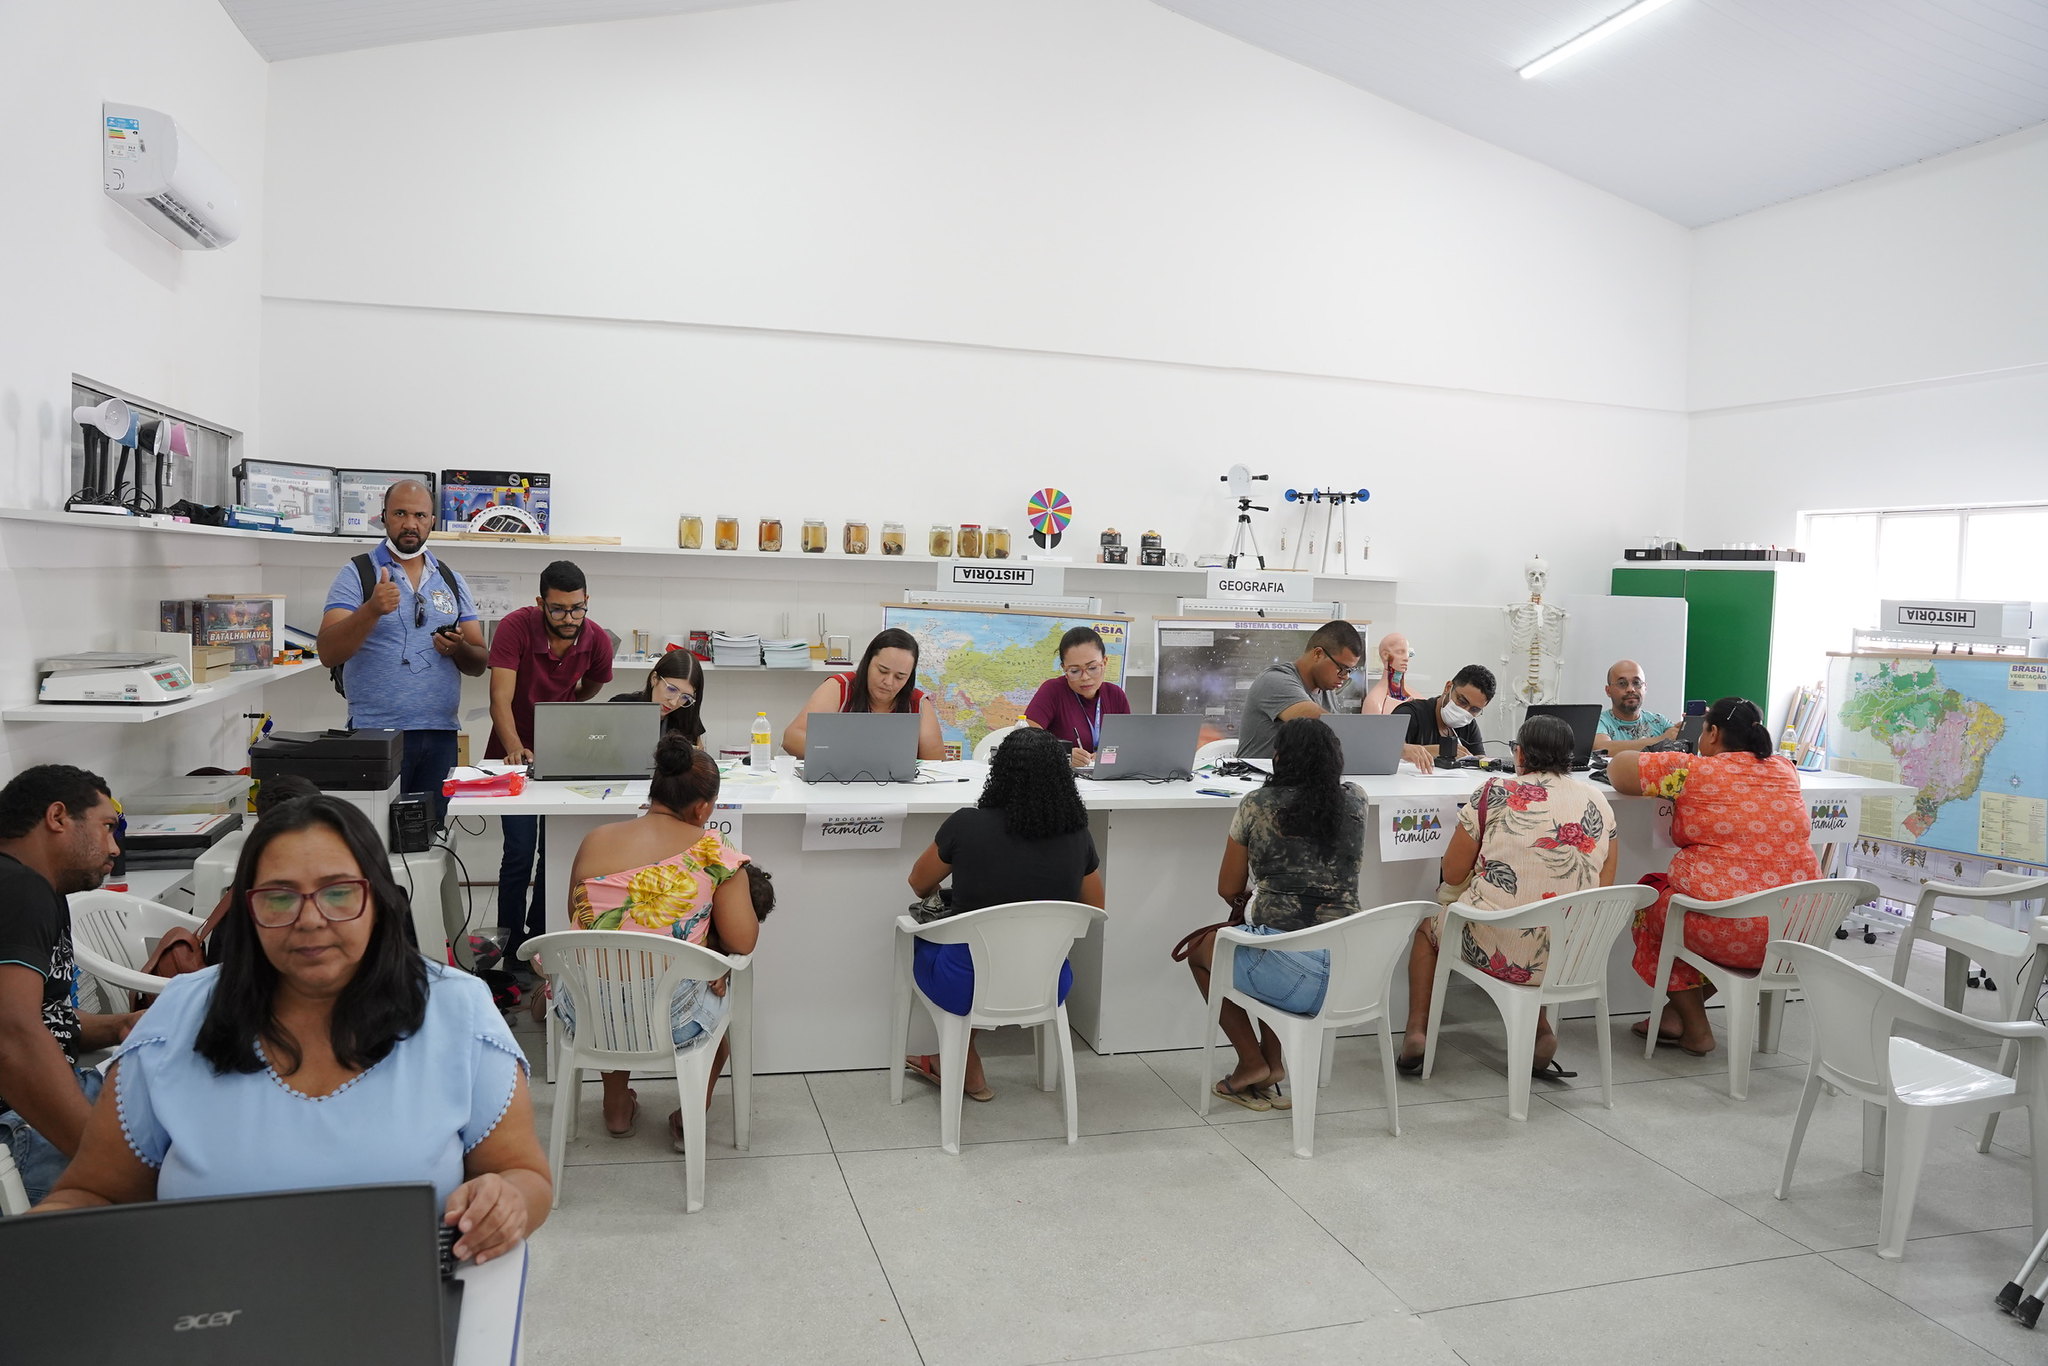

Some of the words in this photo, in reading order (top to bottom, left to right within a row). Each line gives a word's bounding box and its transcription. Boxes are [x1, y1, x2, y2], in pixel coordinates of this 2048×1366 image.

[962, 568, 1025, 582] HISTÓRIA
[1218, 580, 1285, 593] GEOGRAFIA
[1906, 609, 1967, 623] HISTÓRIA
[210, 632, 245, 641] BATALHA
[246, 631, 269, 640] NAVAL
[2012, 665, 2046, 673] BRASIL
[1811, 805, 1849, 819] BOLSA
[1392, 815, 1442, 832] BOLSA
[1394, 829, 1441, 846] família
[173, 1309, 243, 1332] acer
